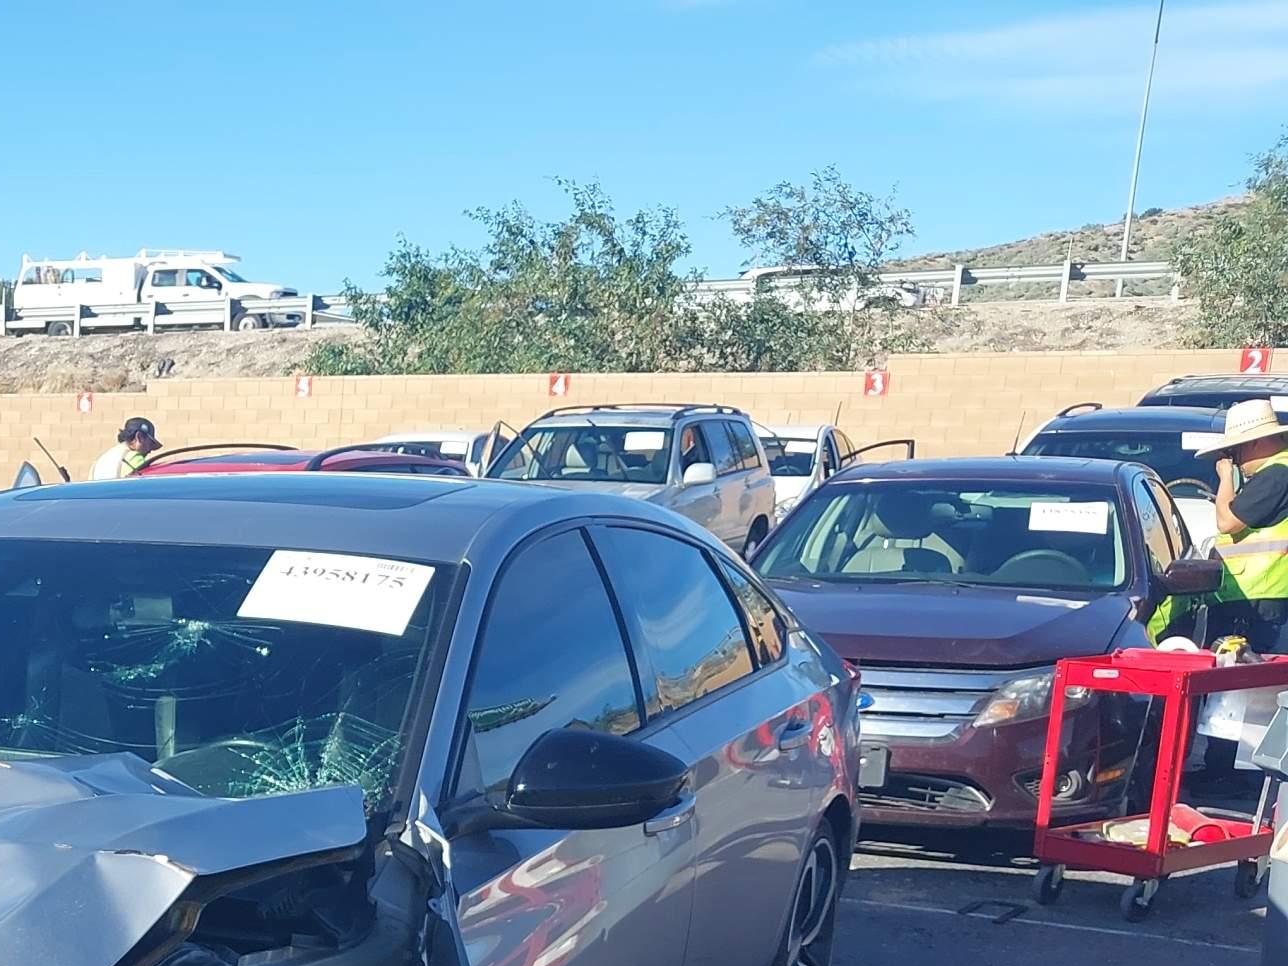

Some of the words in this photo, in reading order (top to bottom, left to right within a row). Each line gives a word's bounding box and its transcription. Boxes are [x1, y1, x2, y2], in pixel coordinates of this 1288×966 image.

[1244, 350, 1263, 374] 2
[298, 375, 309, 398] 5
[552, 374, 566, 396] 4
[868, 372, 883, 395] 3
[79, 392, 90, 412] 6
[279, 565, 407, 589] 43958175
